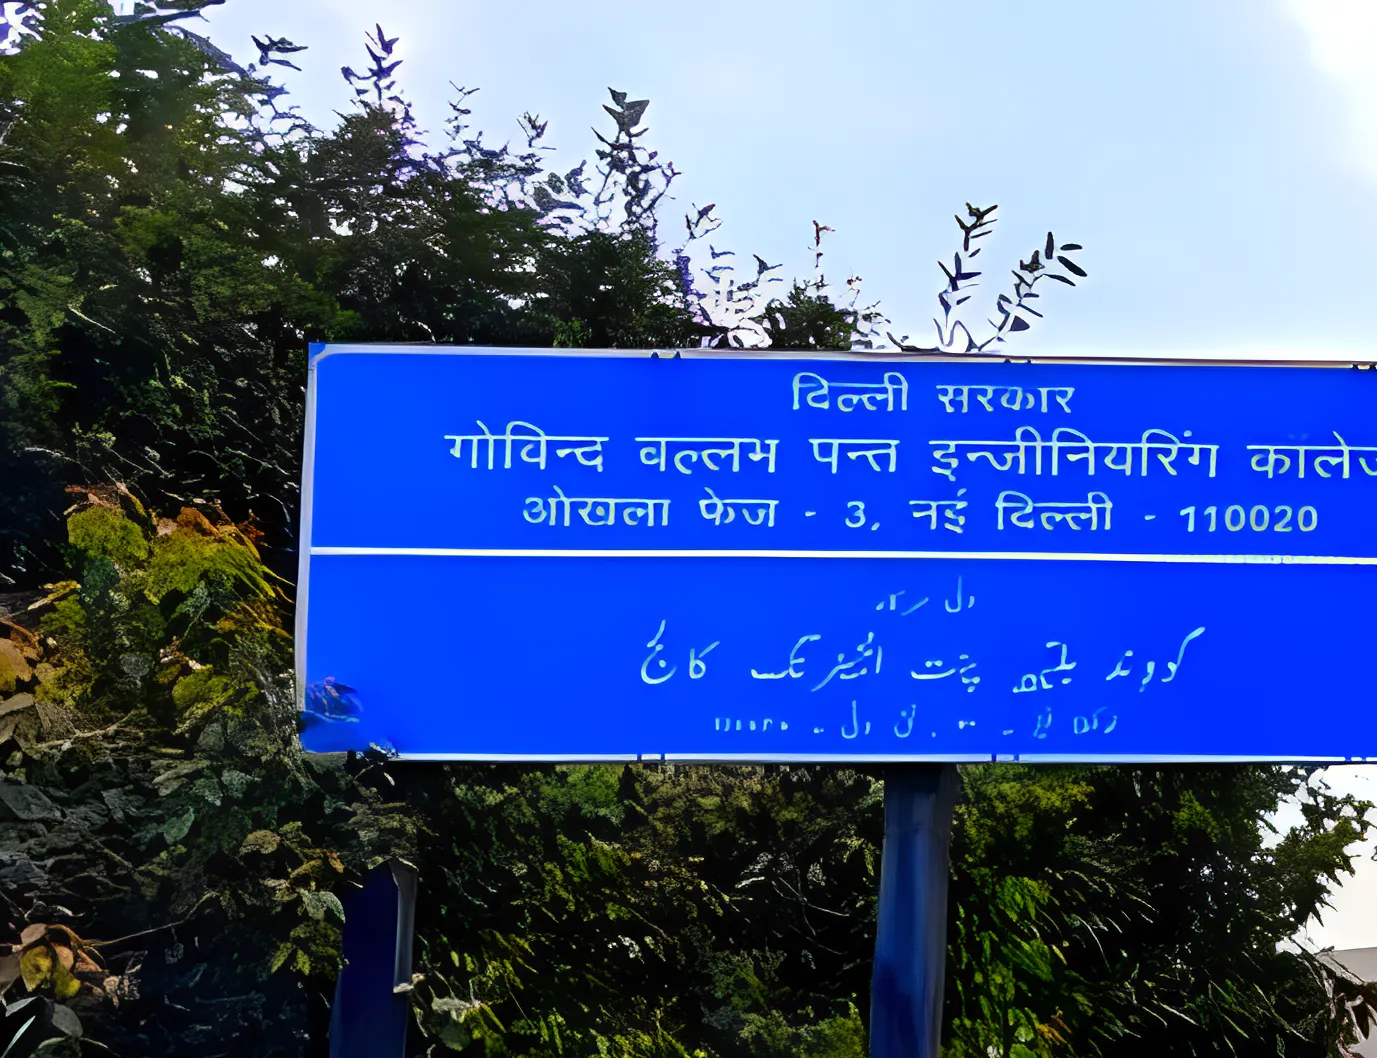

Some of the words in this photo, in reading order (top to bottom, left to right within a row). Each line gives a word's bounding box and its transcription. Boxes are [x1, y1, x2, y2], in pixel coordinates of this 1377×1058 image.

[791, 371, 909, 413] दिल्ली
[935, 384, 1076, 414] सरकार
[443, 419, 610, 473] गोविन्द
[634, 436, 781, 475] वल्लभ
[807, 437, 901, 475] पन्त
[522, 484, 672, 527] ओखला
[698, 486, 780, 528] फेज
[994, 490, 1114, 531] दिल्ली
[1179, 504, 1318, 533] 110020
